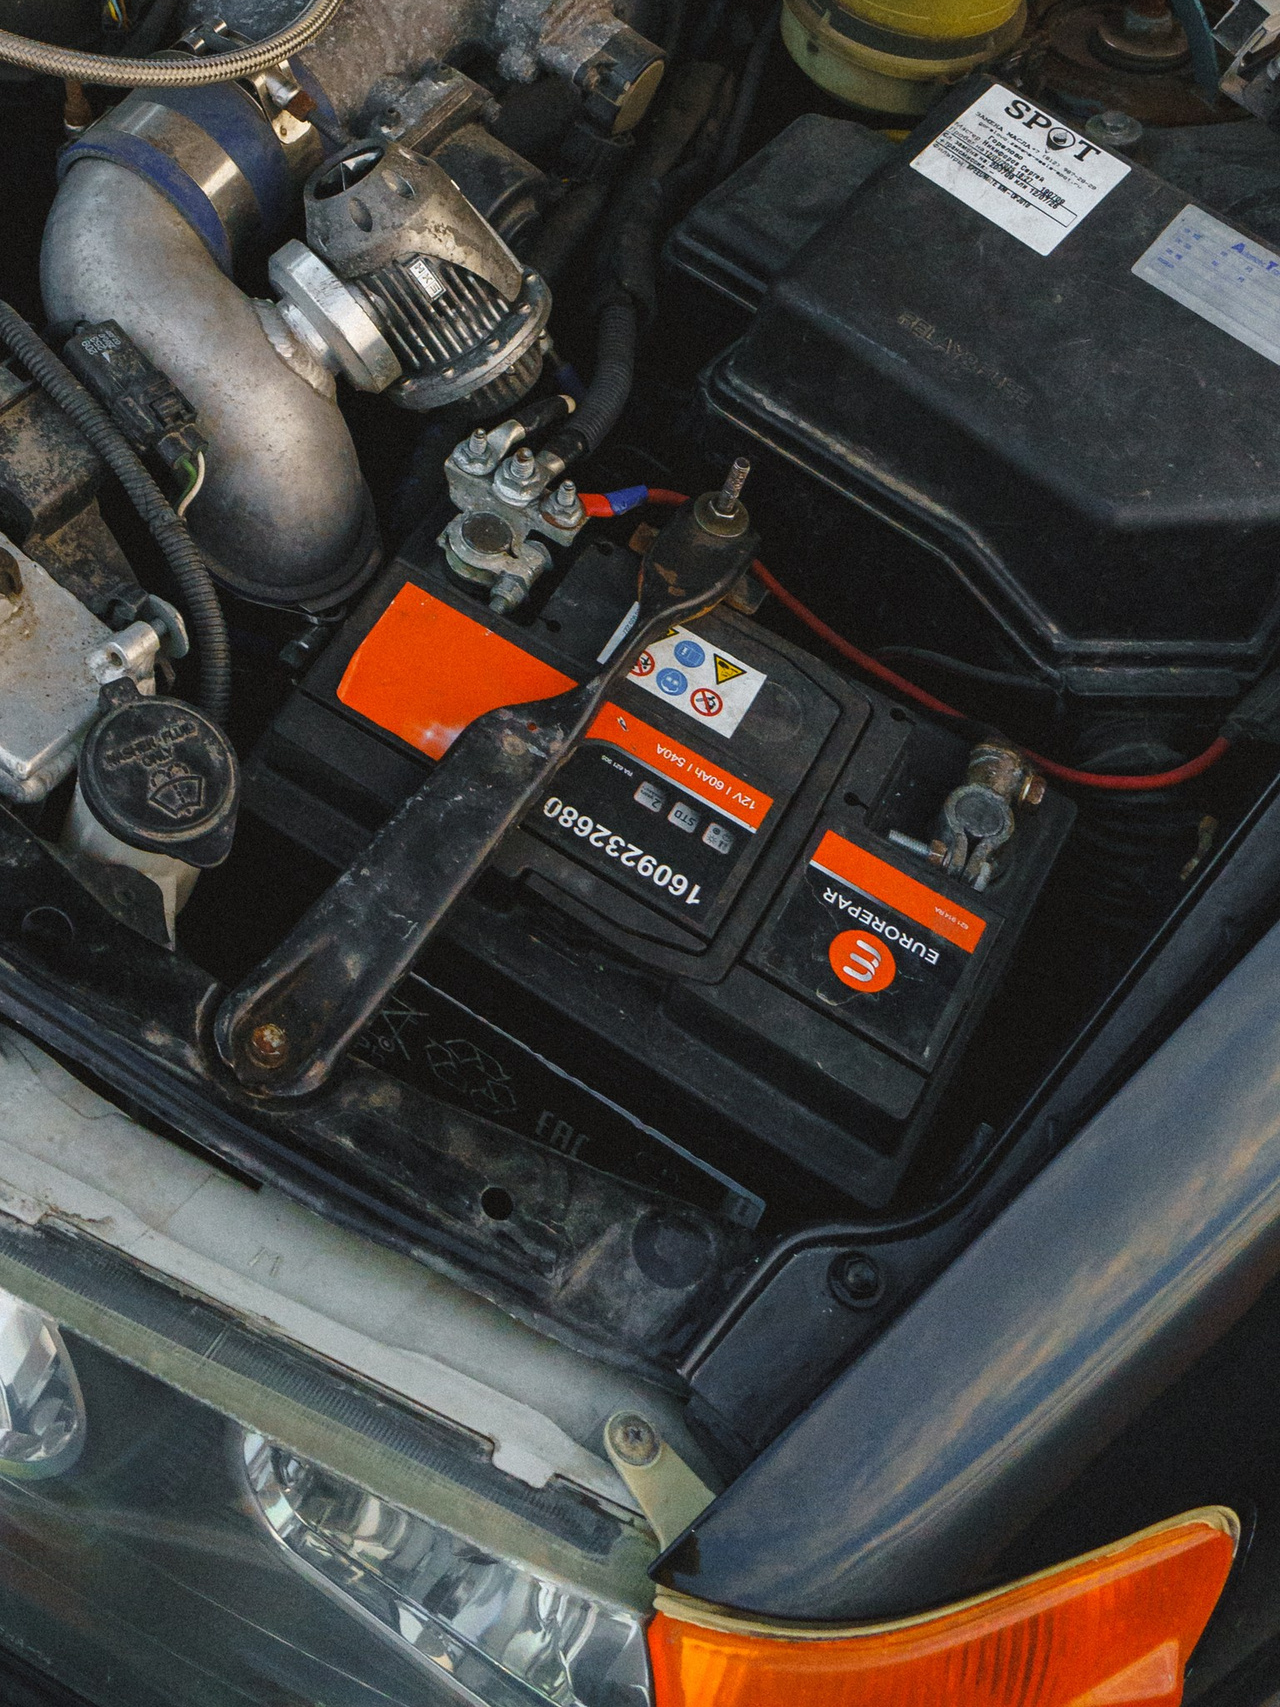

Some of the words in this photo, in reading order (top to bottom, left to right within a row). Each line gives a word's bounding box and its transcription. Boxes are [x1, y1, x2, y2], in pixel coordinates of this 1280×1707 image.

[977, 111, 1003, 131] ЗАМЕНА
[1004, 99, 1100, 161] SPOT
[987, 134, 1023, 160] Горелово
[981, 139, 1019, 166] Никифоров
[1019, 164, 1044, 182] Сергей
[1013, 179, 1027, 189] или
[161, 728, 203, 761] FLUID
[656, 743, 686, 767] 540A
[623, 768, 634, 777] RA
[694, 767, 725, 790] 60Ah
[651, 798, 662, 809] 2
[732, 792, 755, 809] 12V
[674, 809, 698, 827] STD
[544, 798, 700, 904] 1609232680
[934, 906, 945, 916] RA
[823, 888, 939, 964] EUROREPAR
